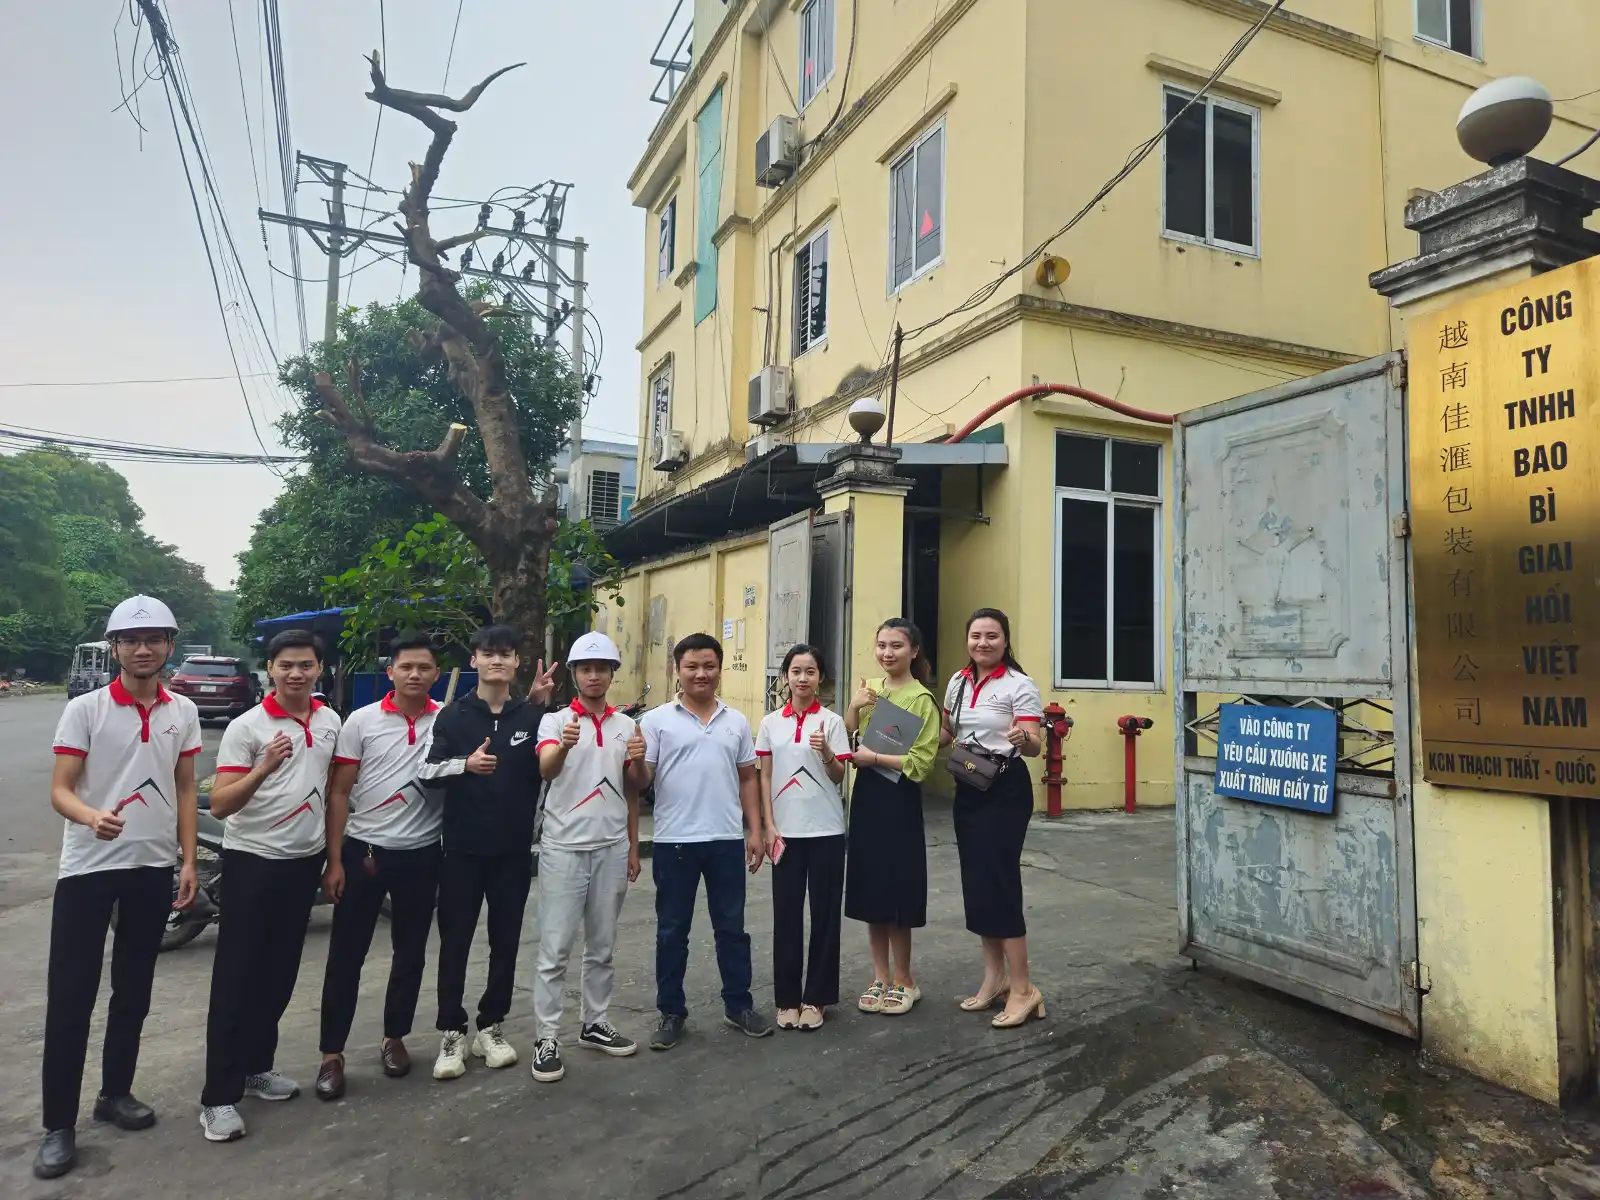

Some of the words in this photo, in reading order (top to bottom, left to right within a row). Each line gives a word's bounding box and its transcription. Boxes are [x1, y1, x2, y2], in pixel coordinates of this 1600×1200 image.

[1501, 290, 1573, 336] CÔNG
[1521, 344, 1552, 379] TY
[1504, 389, 1576, 430] TNHH
[1513, 441, 1568, 478] BAO
[1529, 486, 1556, 524] BÌ
[1518, 541, 1573, 575] GIAI
[1522, 638, 1580, 681] VIỆT
[1240, 715, 1260, 736] VÀO
[1263, 717, 1294, 740] CÔNG
[1297, 723, 1310, 740] TY
[1522, 696, 1588, 727] NAM
[514, 731, 529, 739] NIKE
[1224, 741, 1243, 762] YÊU
[1245, 741, 1267, 765] CẦU
[1270, 745, 1309, 771] XUỐNG
[1311, 753, 1327, 773] XE
[1429, 752, 1455, 773] KCN
[1458, 754, 1502, 780] THẠCH
[1506, 752, 1540, 780] THẤT
[1555, 755, 1596, 785] QUỐC
[1219, 767, 1246, 791] XUẤT
[1248, 773, 1281, 797] TRÌNH
[1283, 776, 1310, 801] GIẤY
[1313, 780, 1329, 804] TỜ
